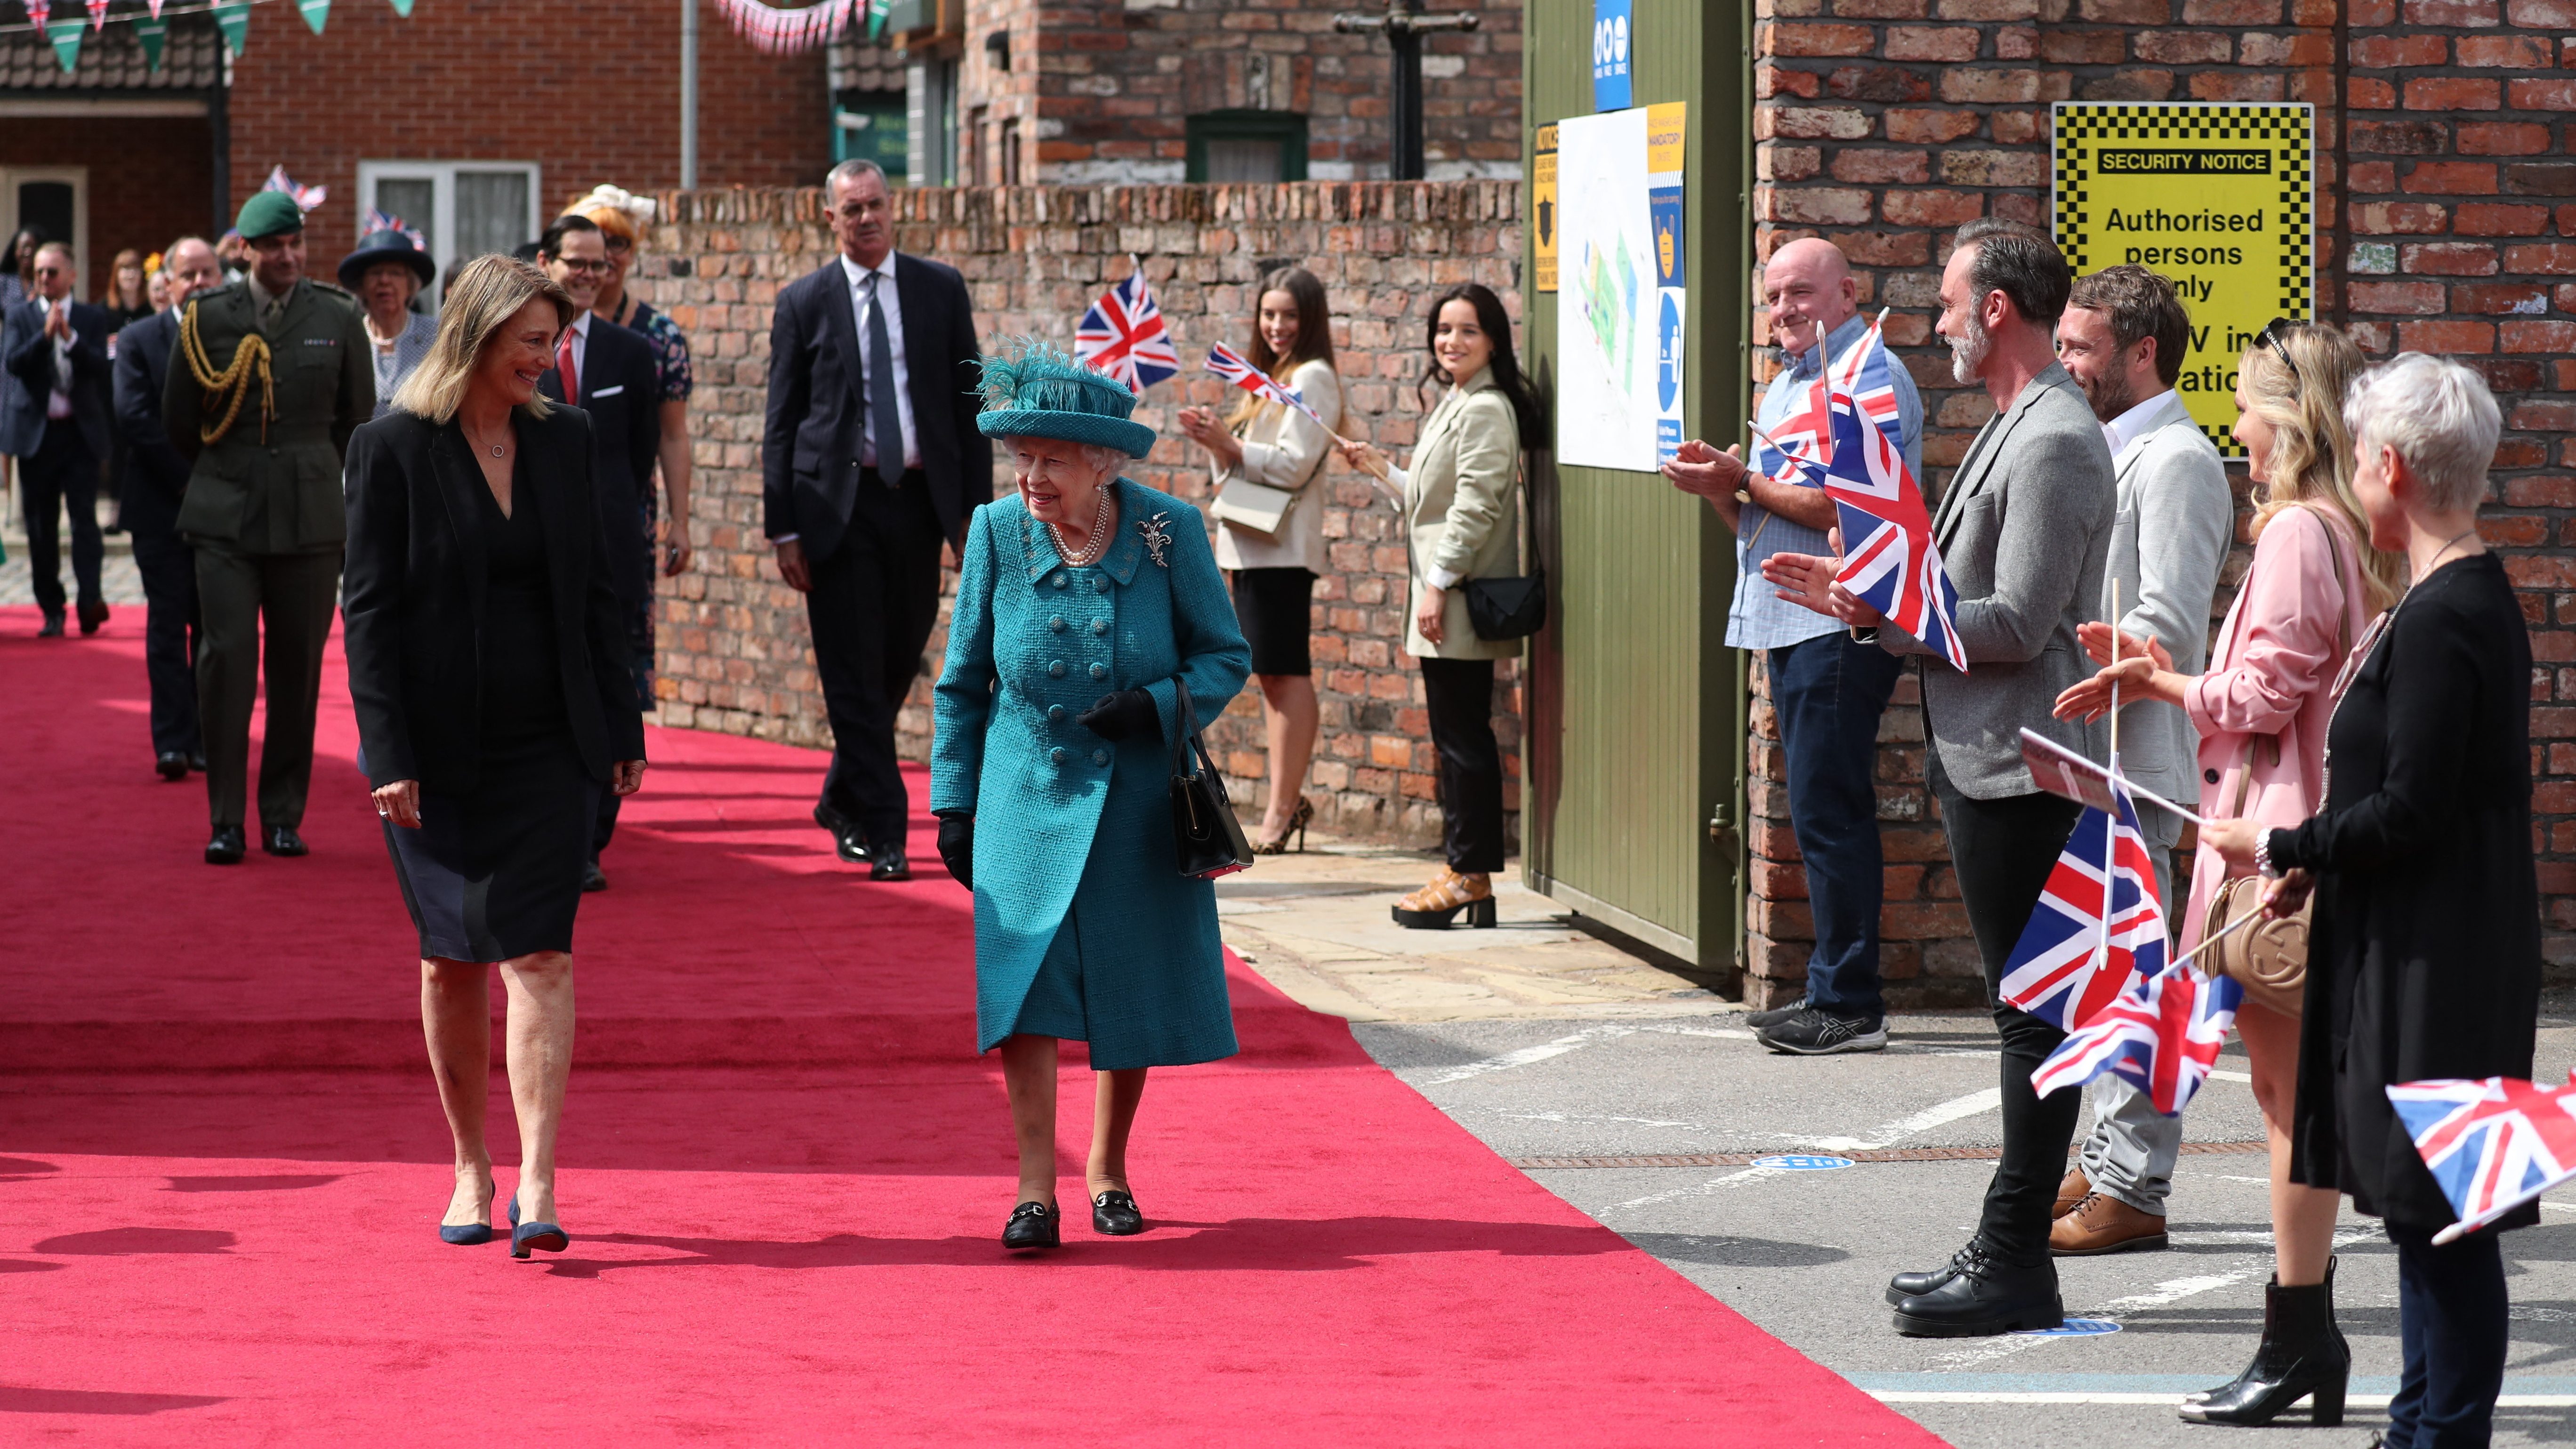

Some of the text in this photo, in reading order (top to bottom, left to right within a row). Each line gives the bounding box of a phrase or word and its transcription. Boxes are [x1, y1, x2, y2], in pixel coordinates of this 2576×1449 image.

[2102, 153, 2267, 169] SECURITY NOTICE
[2106, 208, 2263, 232] Authorised
[2125, 247, 2243, 265] persons
[2174, 274, 2214, 302] nly
[2266, 331, 2285, 358] CHANEL
